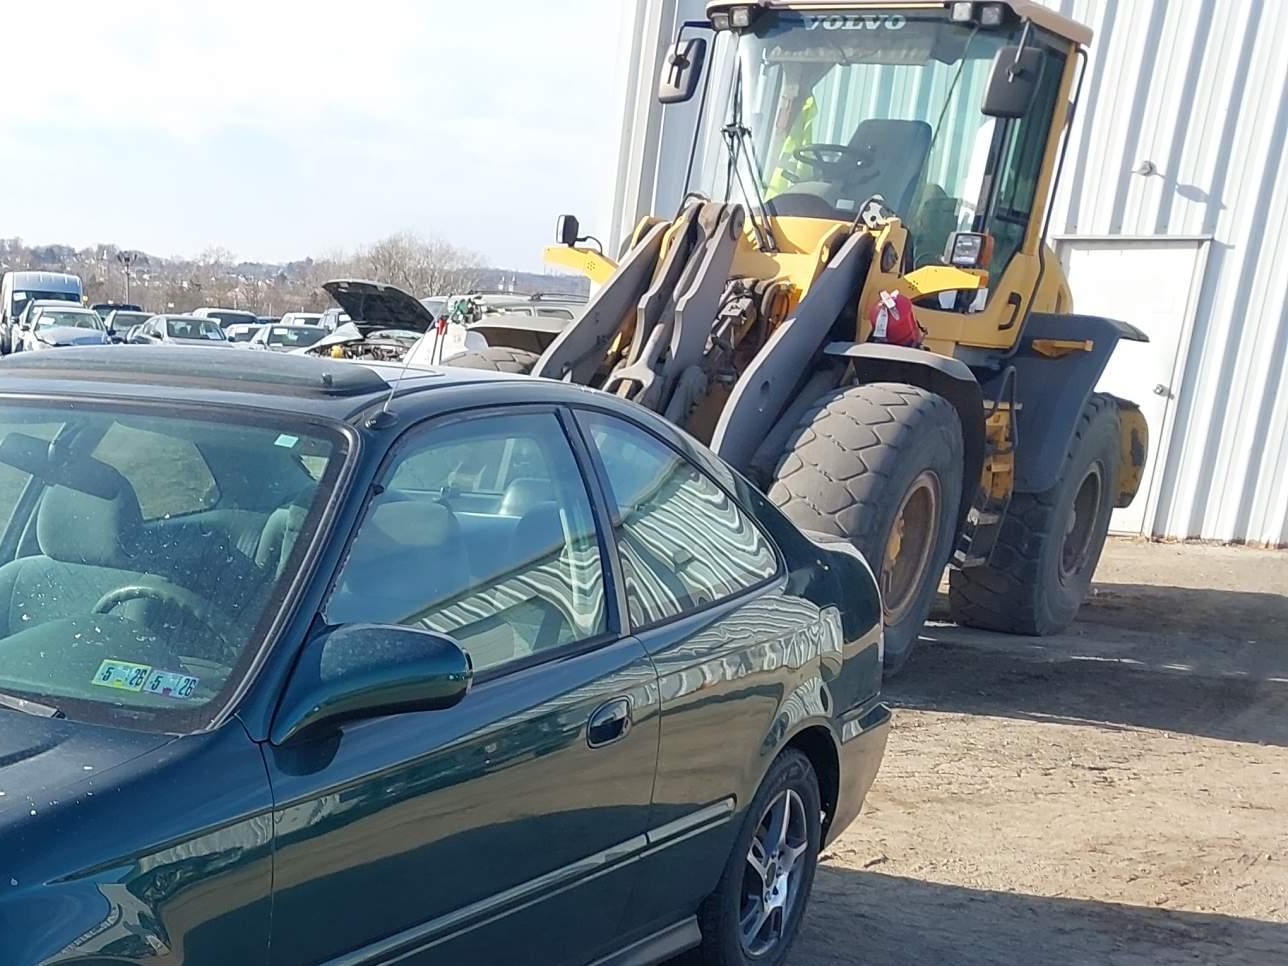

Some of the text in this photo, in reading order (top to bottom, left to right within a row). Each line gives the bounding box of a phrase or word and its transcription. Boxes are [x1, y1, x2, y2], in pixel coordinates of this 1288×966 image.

[801, 14, 907, 31] VOLVO
[102, 667, 147, 686] 5 26
[151, 675, 163, 690] 5
